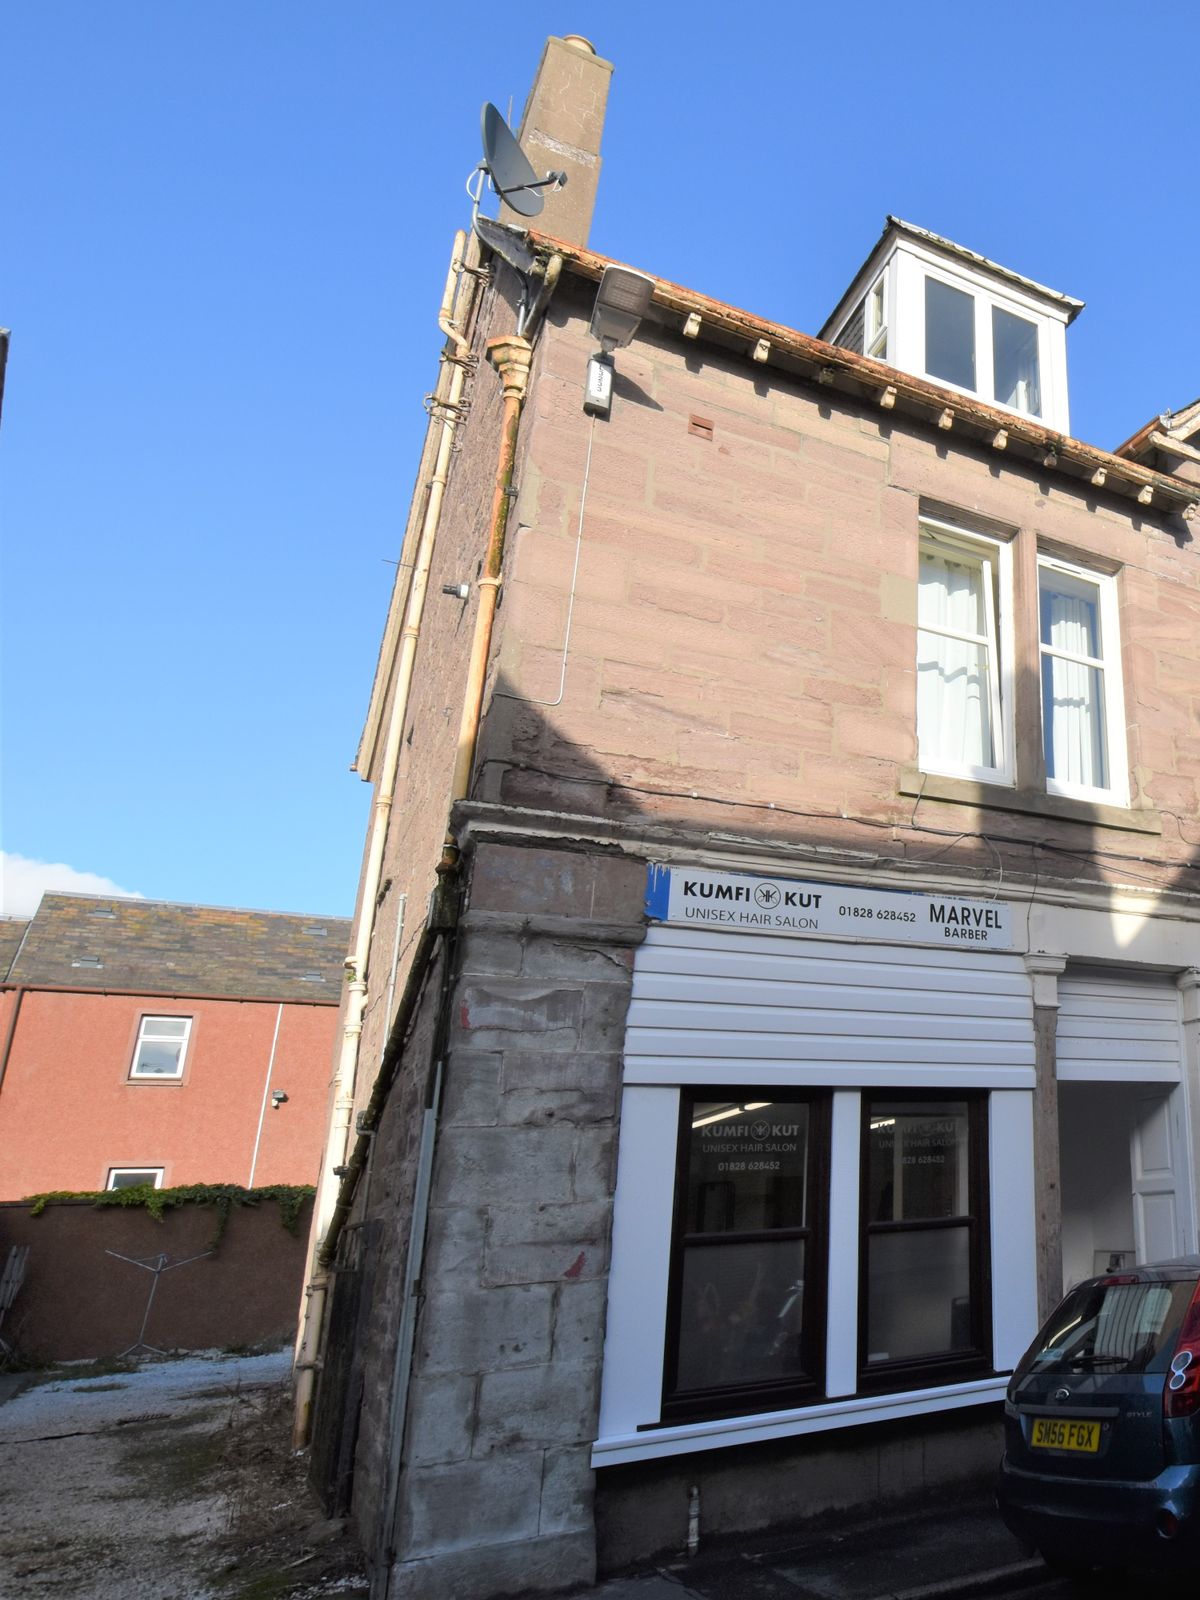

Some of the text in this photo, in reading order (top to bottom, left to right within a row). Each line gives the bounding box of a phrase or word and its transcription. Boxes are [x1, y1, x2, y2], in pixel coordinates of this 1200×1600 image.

[683, 880, 751, 902] KUMFI
[785, 892, 822, 909] KUT
[685, 907, 819, 929] UNISEX HAIR SALON
[838, 905, 917, 923] 01828 628452
[929, 903, 1003, 929] MARVEL
[944, 927, 988, 941] BARBER
[702, 1125, 749, 1137] KUMFI
[772, 1124, 800, 1136] KUT
[703, 1142, 797, 1152] UNISEX HAIR SALON
[718, 1160, 780, 1171] 01828 628452
[1036, 1421, 1095, 1448] SM56 FGX
